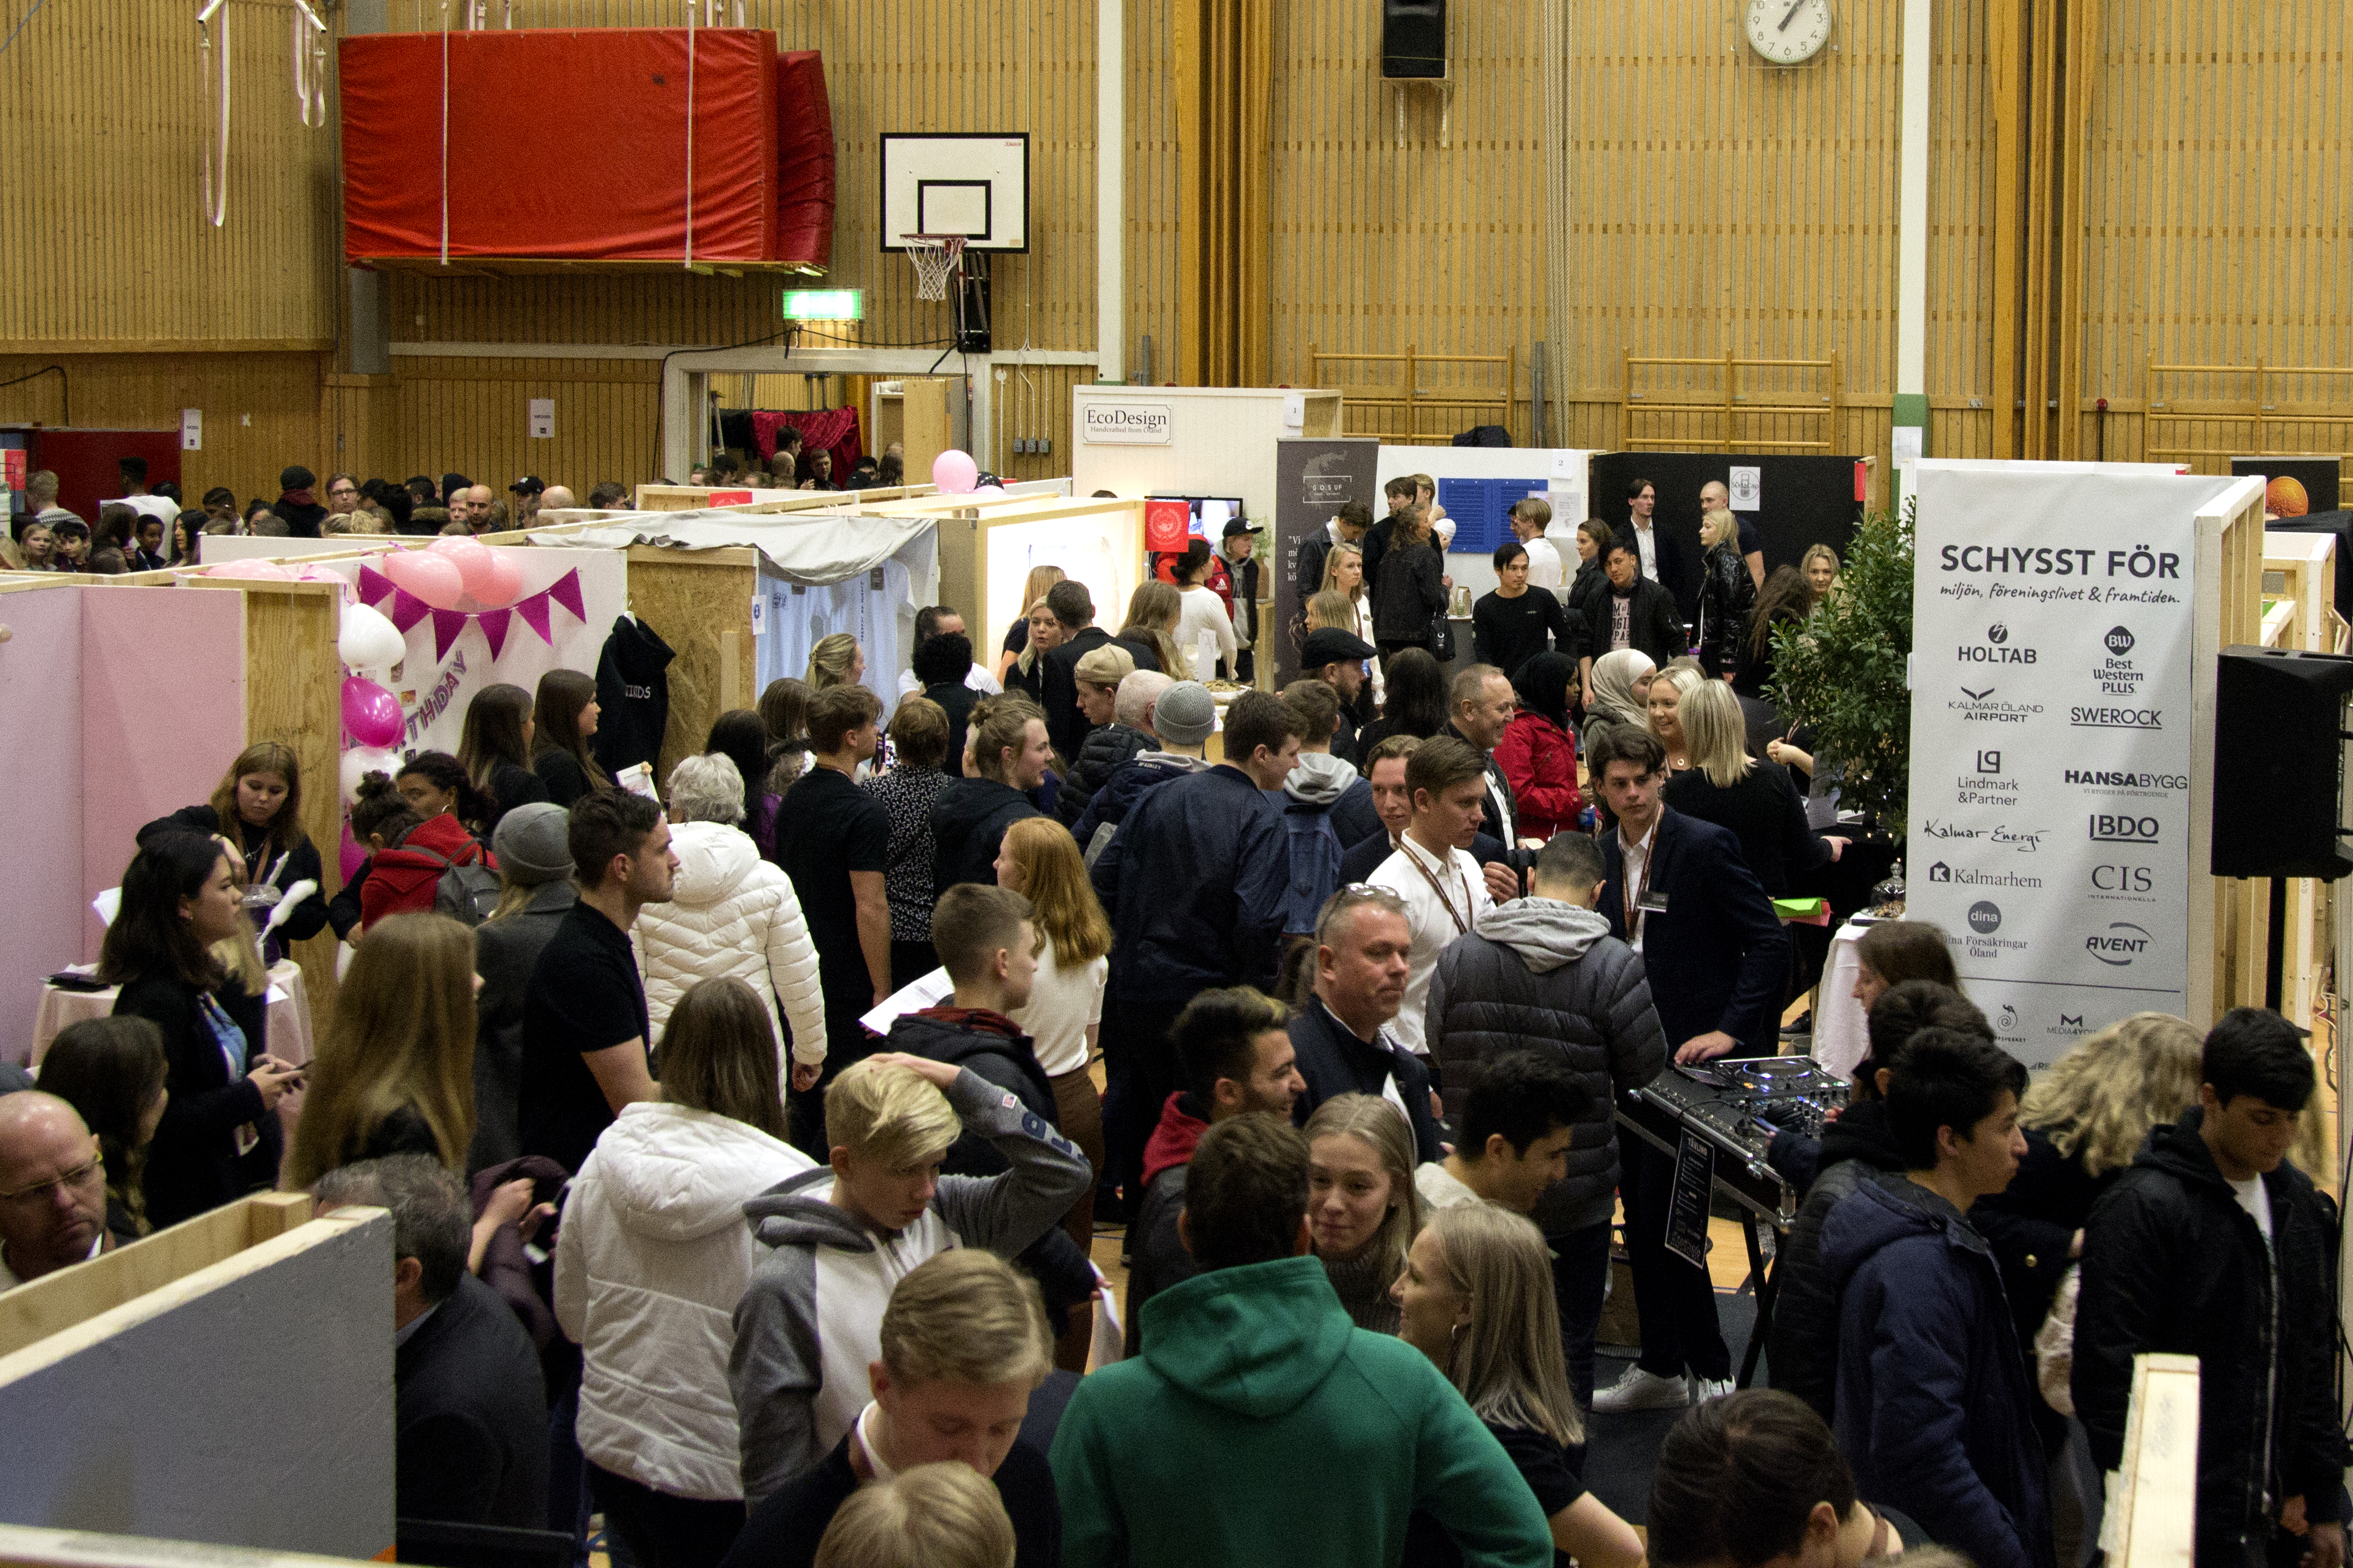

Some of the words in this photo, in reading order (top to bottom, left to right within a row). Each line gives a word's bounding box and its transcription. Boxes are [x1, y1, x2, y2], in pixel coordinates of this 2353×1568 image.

[1087, 409, 1167, 429] EcoDesign
[1941, 545, 2095, 575] SCHYSST
[2108, 544, 2180, 579] FÖR
[1940, 582, 1983, 601] miljön,
[1989, 583, 2085, 603] föreningslivet
[2088, 587, 2101, 602] &
[2106, 587, 2180, 604] framtiden.
[2109, 635, 2131, 648] BW
[1958, 646, 2037, 664] HOLTAB
[2106, 659, 2133, 670] Best
[2093, 669, 2144, 681] Western
[1948, 701, 1999, 711] KALMAR
[2001, 701, 2044, 713] ÖLAND
[1964, 712, 2028, 723] AIRPORT
[2071, 707, 2161, 726] SWEROCK
[1958, 777, 2019, 791] Lindmark
[2065, 770, 2188, 790] HANSABYGG
[1958, 792, 2018, 805] &Partner
[2099, 815, 2159, 838] BDO
[1924, 818, 1988, 839] Kalmar
[1991, 825, 2050, 852] Energi
[1954, 869, 2042, 888] Kalmarhem
[2091, 865, 2152, 892] CIS
[1970, 910, 1999, 923] dina
[1966, 936, 2028, 950] Försäkringar
[2087, 937, 2148, 953] AVENT
[1970, 946, 1997, 958] Öland
